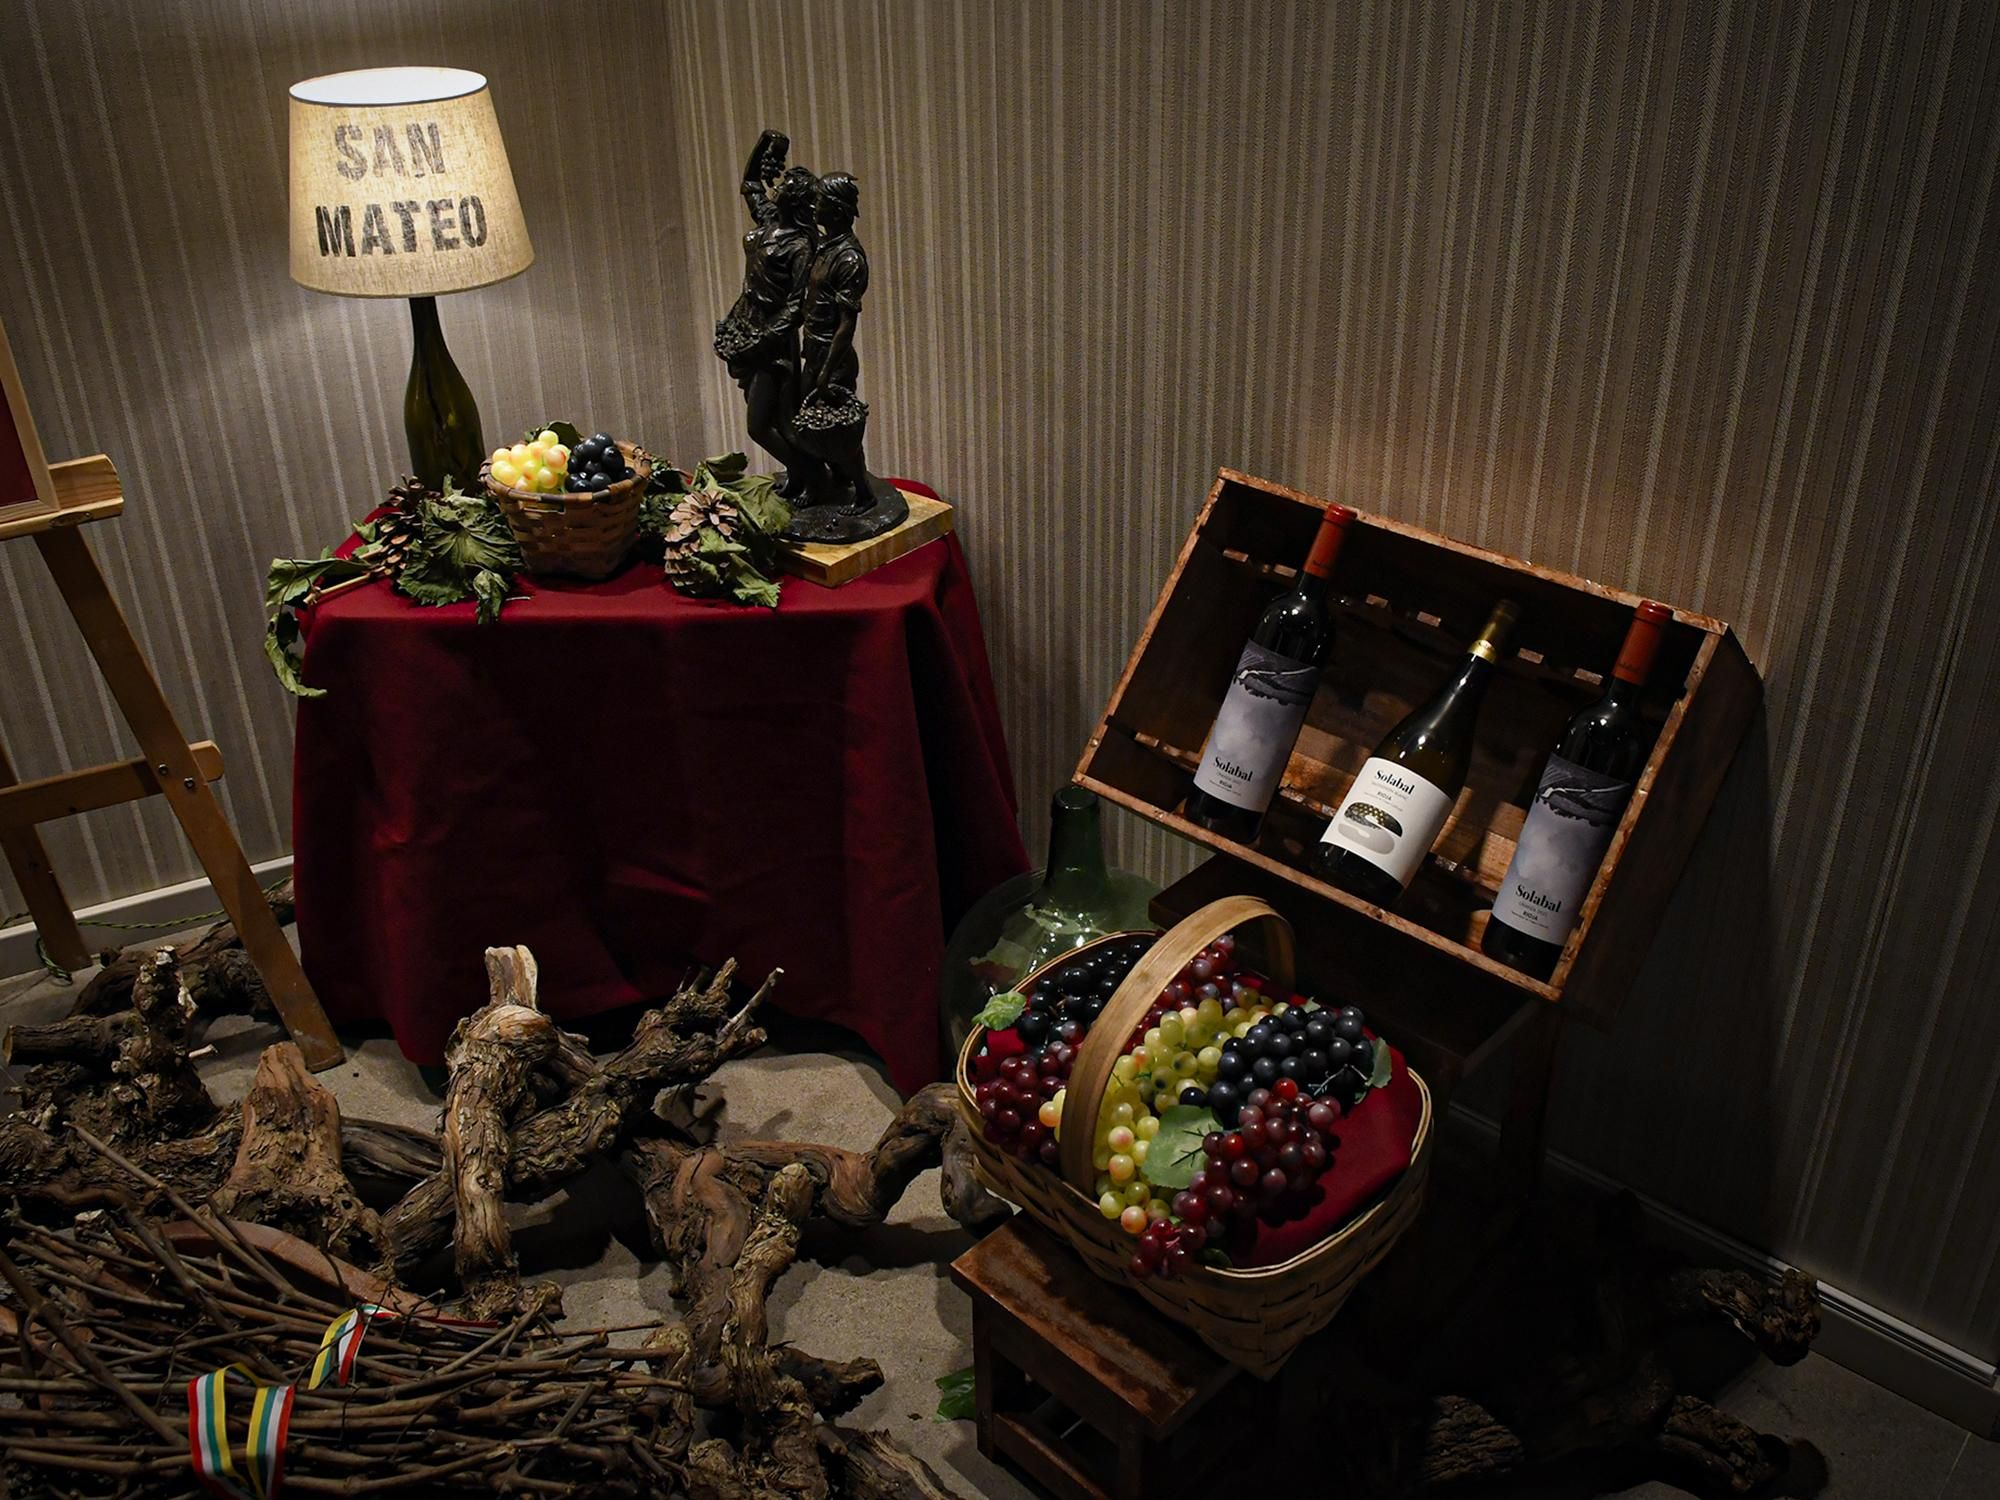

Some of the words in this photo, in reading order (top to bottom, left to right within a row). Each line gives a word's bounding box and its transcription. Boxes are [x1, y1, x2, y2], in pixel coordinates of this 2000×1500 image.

[335, 122, 446, 181] SAN
[315, 195, 488, 257] MATEO
[1213, 757, 1254, 782] Solabal
[1374, 769, 1415, 795] Solabal
[1515, 884, 1562, 914] Solabal
